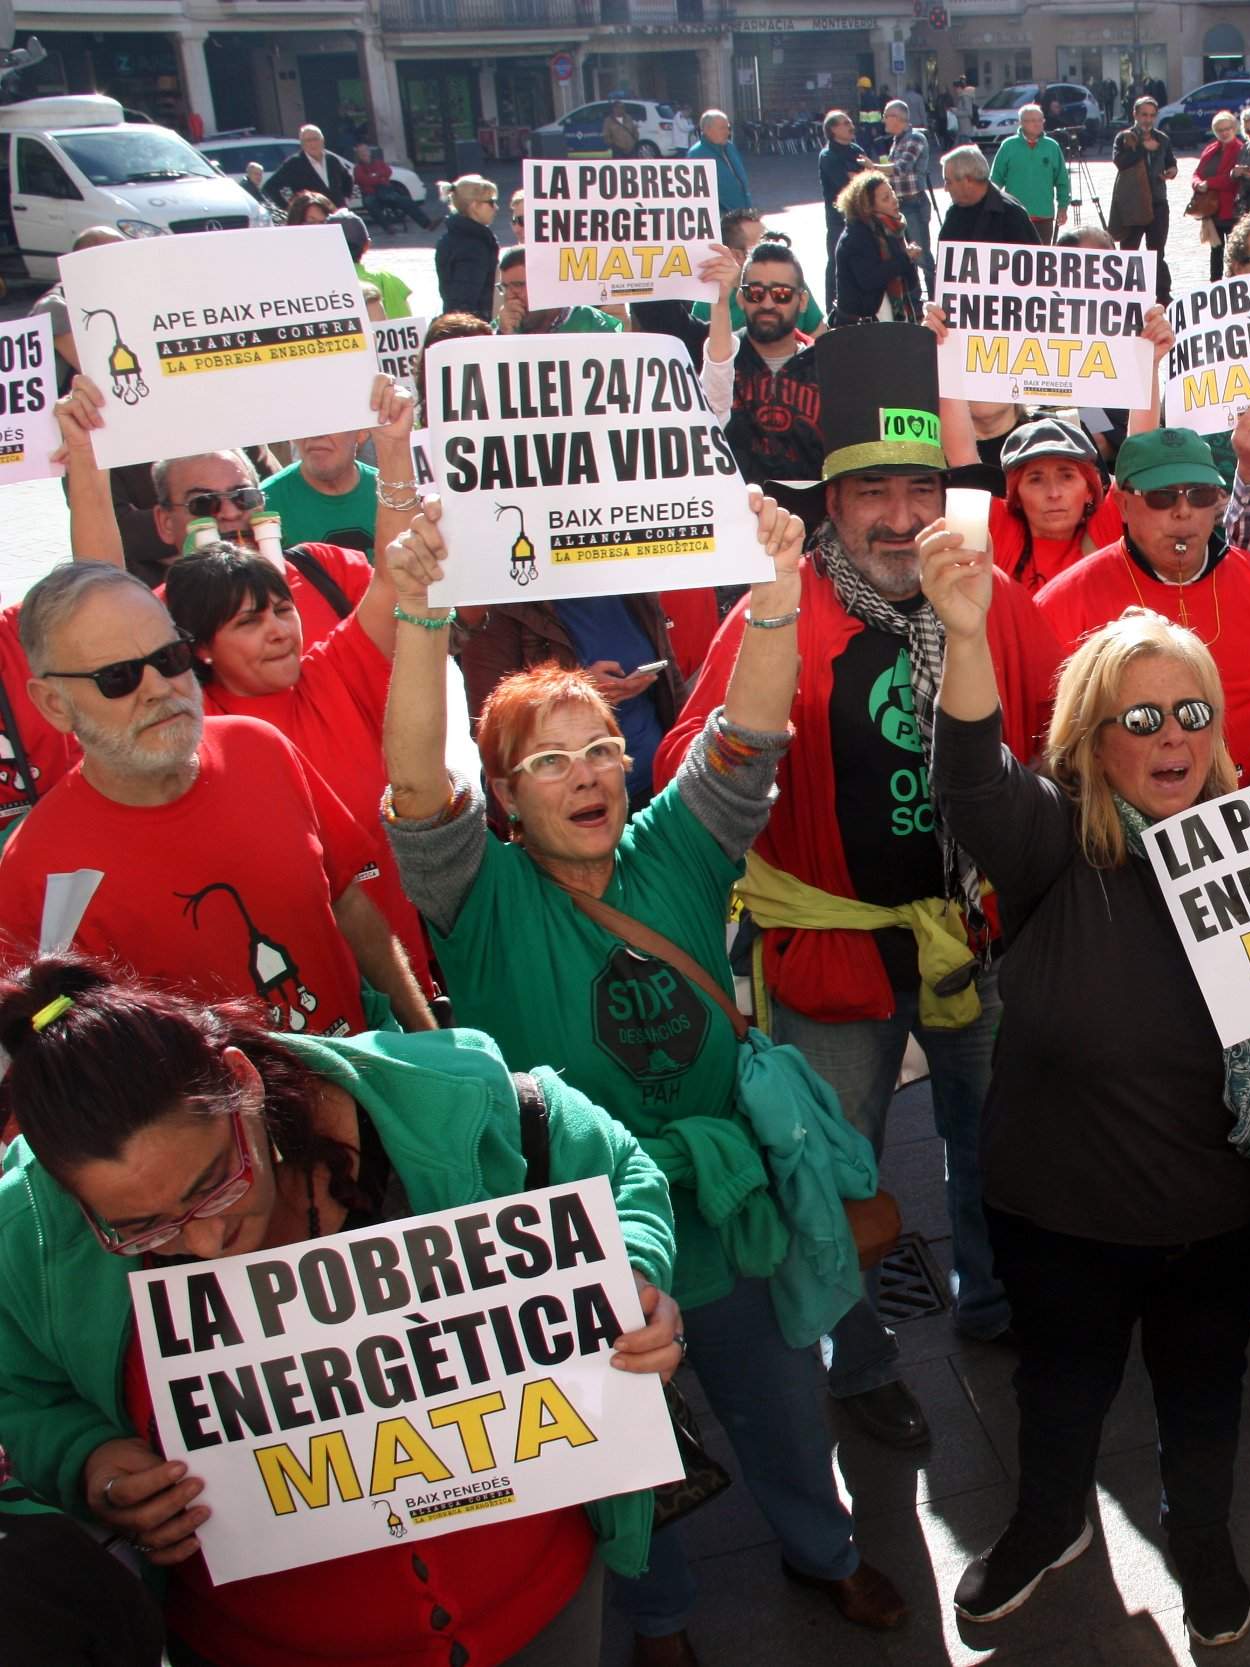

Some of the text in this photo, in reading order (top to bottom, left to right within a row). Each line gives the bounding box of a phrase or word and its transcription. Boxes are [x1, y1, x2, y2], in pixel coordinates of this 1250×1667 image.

[533, 165, 710, 200] LA POBRESA
[534, 202, 715, 242] ENERGÈTICA
[559, 245, 692, 281] MATA
[943, 246, 1146, 292] LA POBRESA
[152, 290, 355, 331] APE BAIX PENEDÉS
[942, 291, 1145, 337] ENERGÈTICA
[162, 321, 358, 355] ALIANÇA CONTRA
[167, 339, 360, 373] LA POBRESA ENERGÈTICA
[966, 335, 1117, 379] MATA
[441, 362, 490, 422] LA
[497, 360, 573, 420] LLEI
[445, 431, 600, 493] SALVA
[608, 425, 737, 482] VIDES
[549, 496, 714, 529] BAIX PENEDÉS
[553, 526, 709, 547] ALIANÇA CONTRA
[555, 541, 709, 562] LA POBRESA ENERGÈTICA
[1154, 814, 1225, 881] LA
[147, 1193, 606, 1359] LA POBRESA
[168, 1283, 625, 1453] ENERGÈTICA
[253, 1377, 598, 1516] MATA
[406, 1475, 511, 1508] BAIX PENEDÉS
